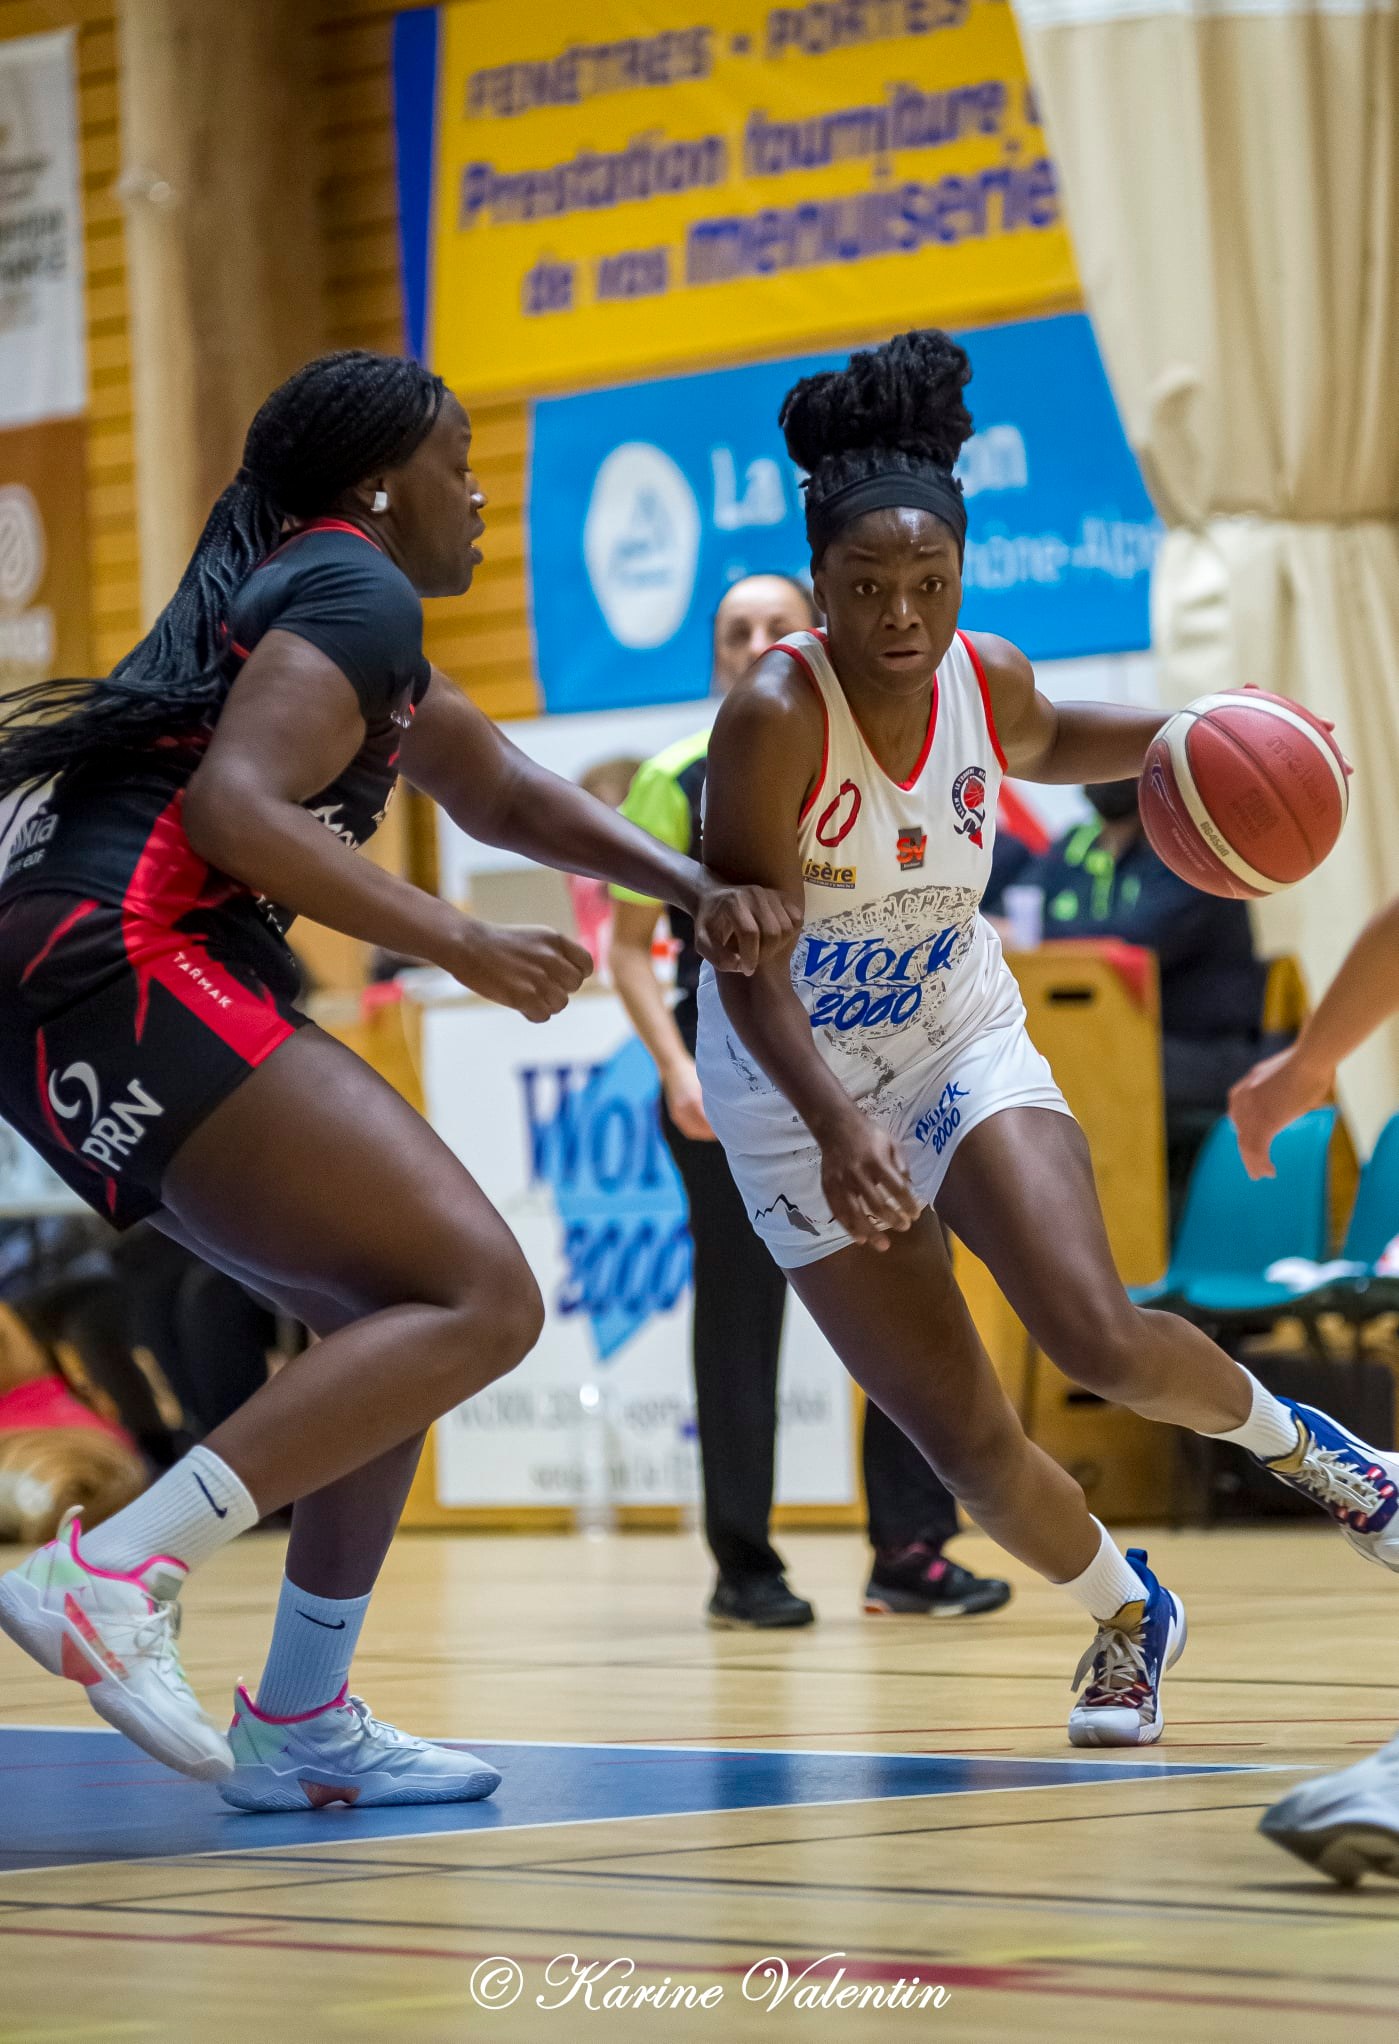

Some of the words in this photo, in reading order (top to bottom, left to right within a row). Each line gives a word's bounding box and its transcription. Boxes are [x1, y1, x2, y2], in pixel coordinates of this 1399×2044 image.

[458, 130, 727, 232] Prestation
[521, 247, 576, 317] de
[594, 245, 669, 303] vos
[711, 446, 788, 531] La
[804, 858, 854, 882] isère
[173, 951, 233, 1009] TARMAK
[804, 922, 960, 984] Work
[809, 983, 923, 1031] 2000
[80, 1078, 165, 1172] PRN
[932, 1106, 961, 1156] 2000
[555, 1219, 695, 1319] 2000
